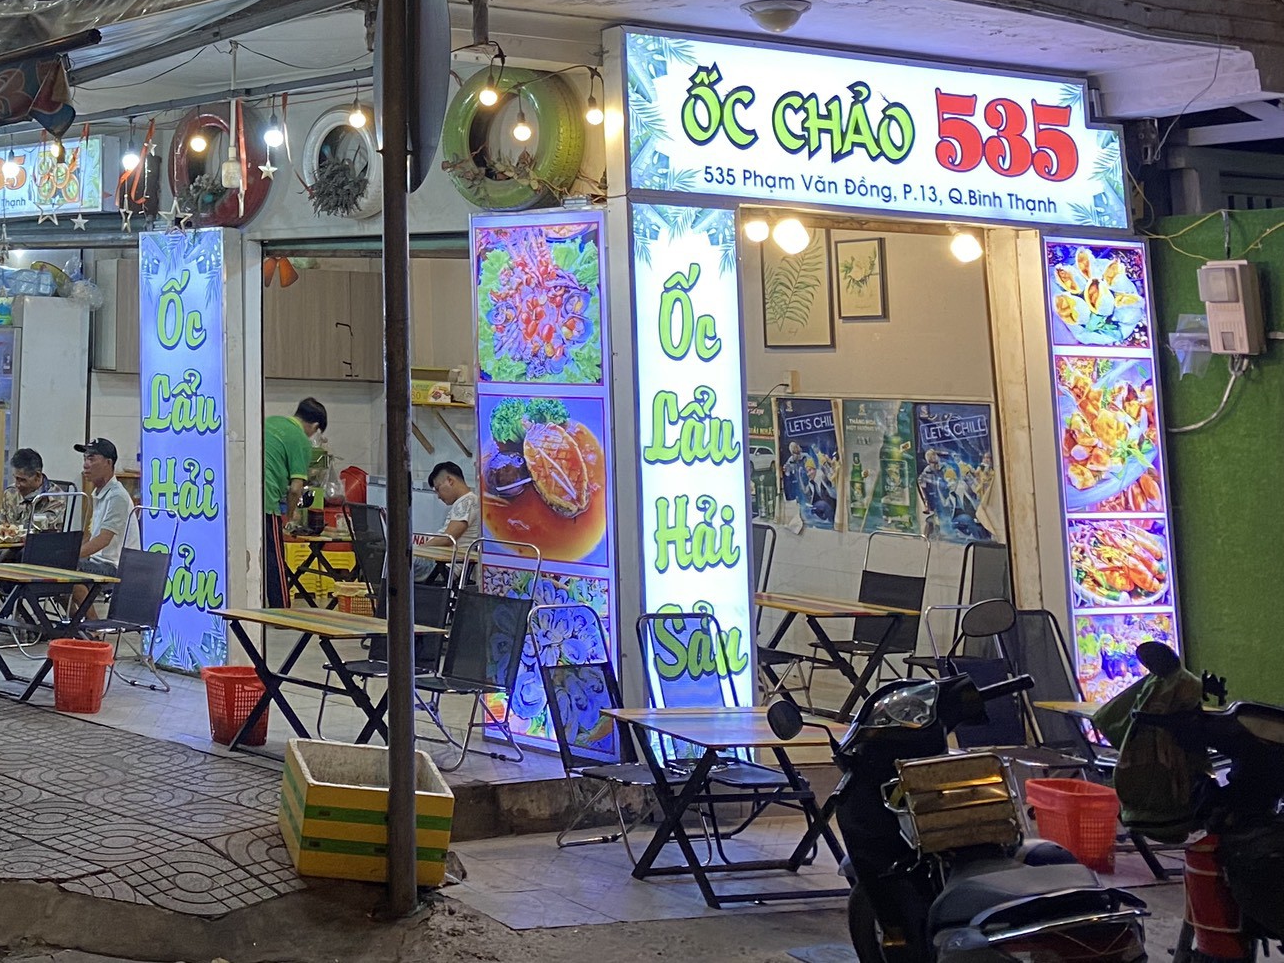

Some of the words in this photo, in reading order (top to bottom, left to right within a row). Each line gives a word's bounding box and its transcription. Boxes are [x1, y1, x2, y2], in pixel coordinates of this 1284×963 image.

[680, 61, 756, 150] ỐC
[771, 80, 916, 165] CHẢO
[934, 87, 1079, 182] 535
[703, 166, 737, 186] 535
[743, 171, 793, 193] Phạm
[801, 173, 838, 195] Văn
[845, 176, 898, 203] Đồng,
[903, 184, 943, 206] P.13,
[948, 186, 1003, 209] Q.Bình
[1007, 192, 1057, 215] Thạnh
[156, 270, 207, 350] Ốc
[658, 263, 721, 361] Ốc
[143, 369, 222, 436] Lẩu
[642, 384, 742, 466] Lẩu
[789, 417, 812, 432] LET'S
[924, 424, 951, 440] LET'S
[952, 419, 987, 436] CHILL
[149, 457, 219, 520] Hải
[653, 494, 741, 573] Hải
